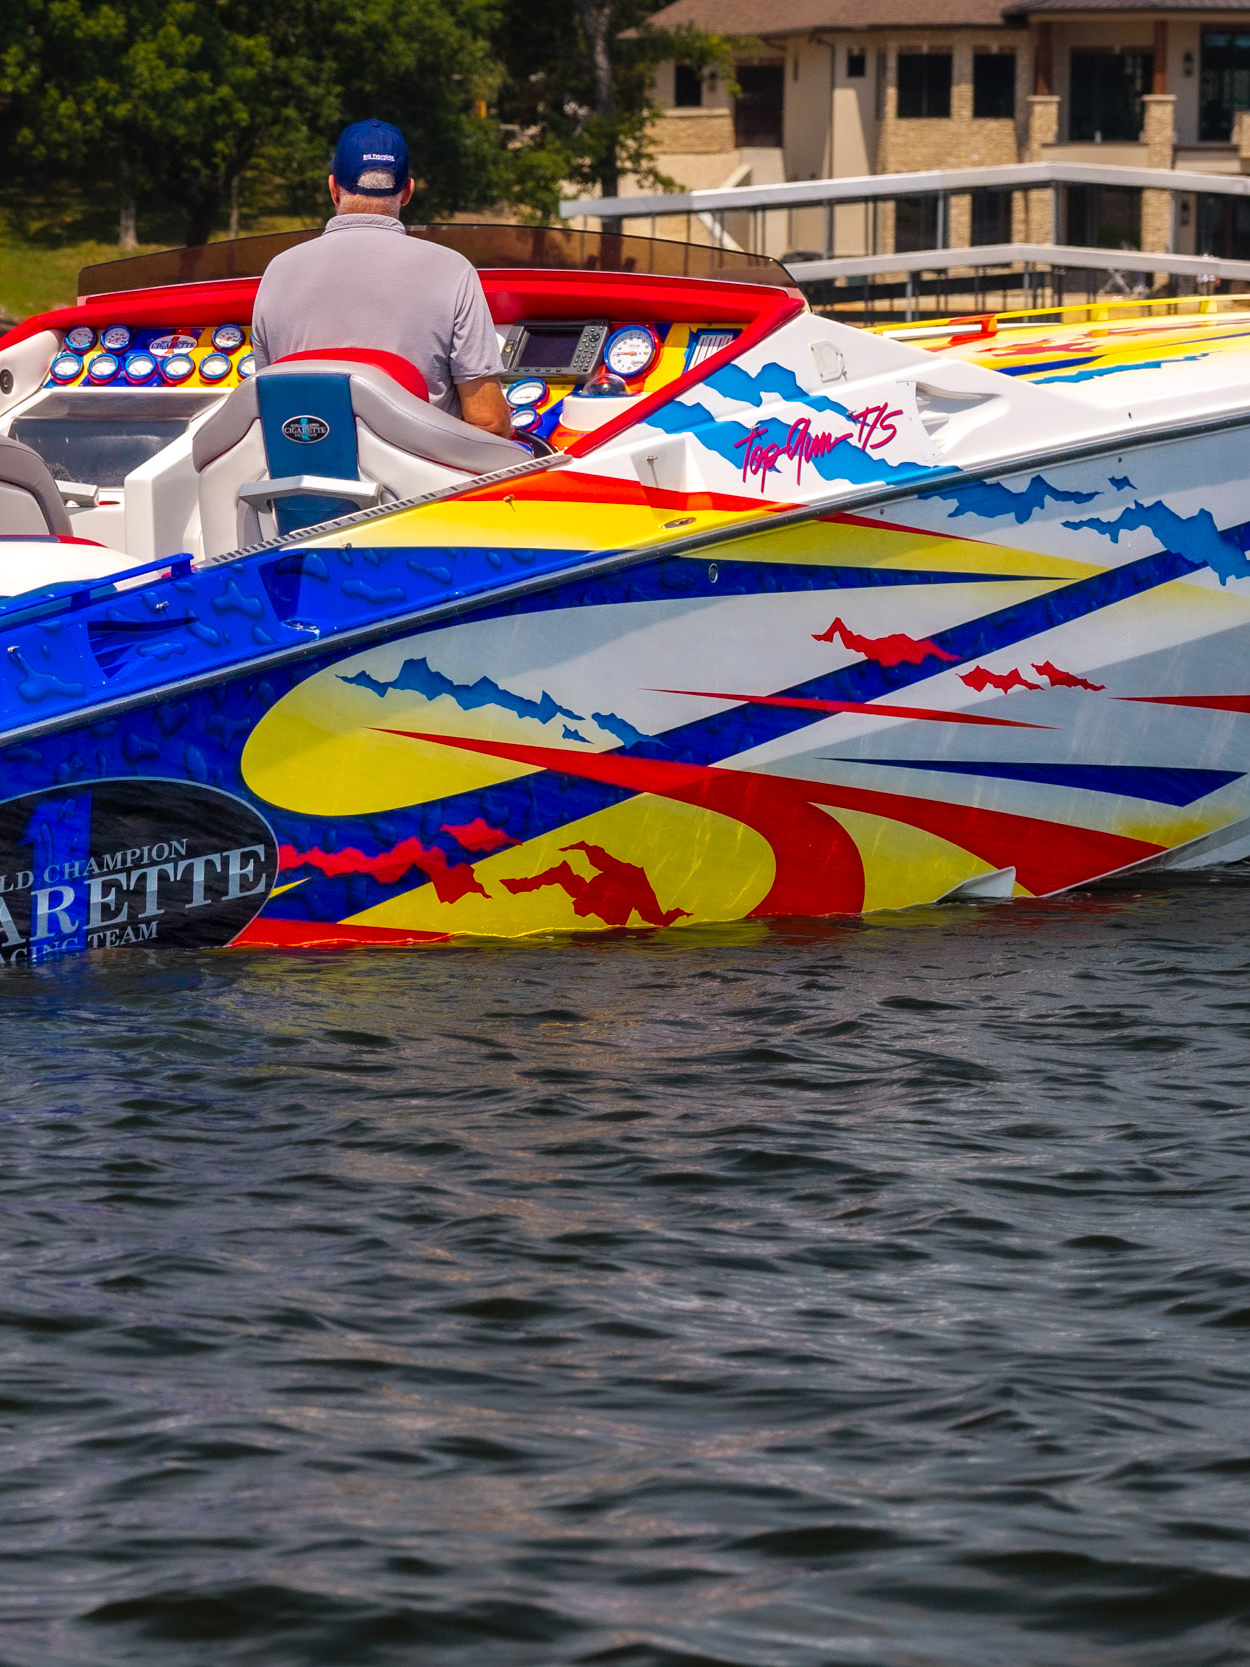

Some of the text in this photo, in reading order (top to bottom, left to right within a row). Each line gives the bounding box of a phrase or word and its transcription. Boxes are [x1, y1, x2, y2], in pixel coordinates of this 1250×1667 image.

[734, 428, 783, 493] Top
[43, 838, 189, 884] CHAMPION
[87, 920, 159, 949] TEAM
